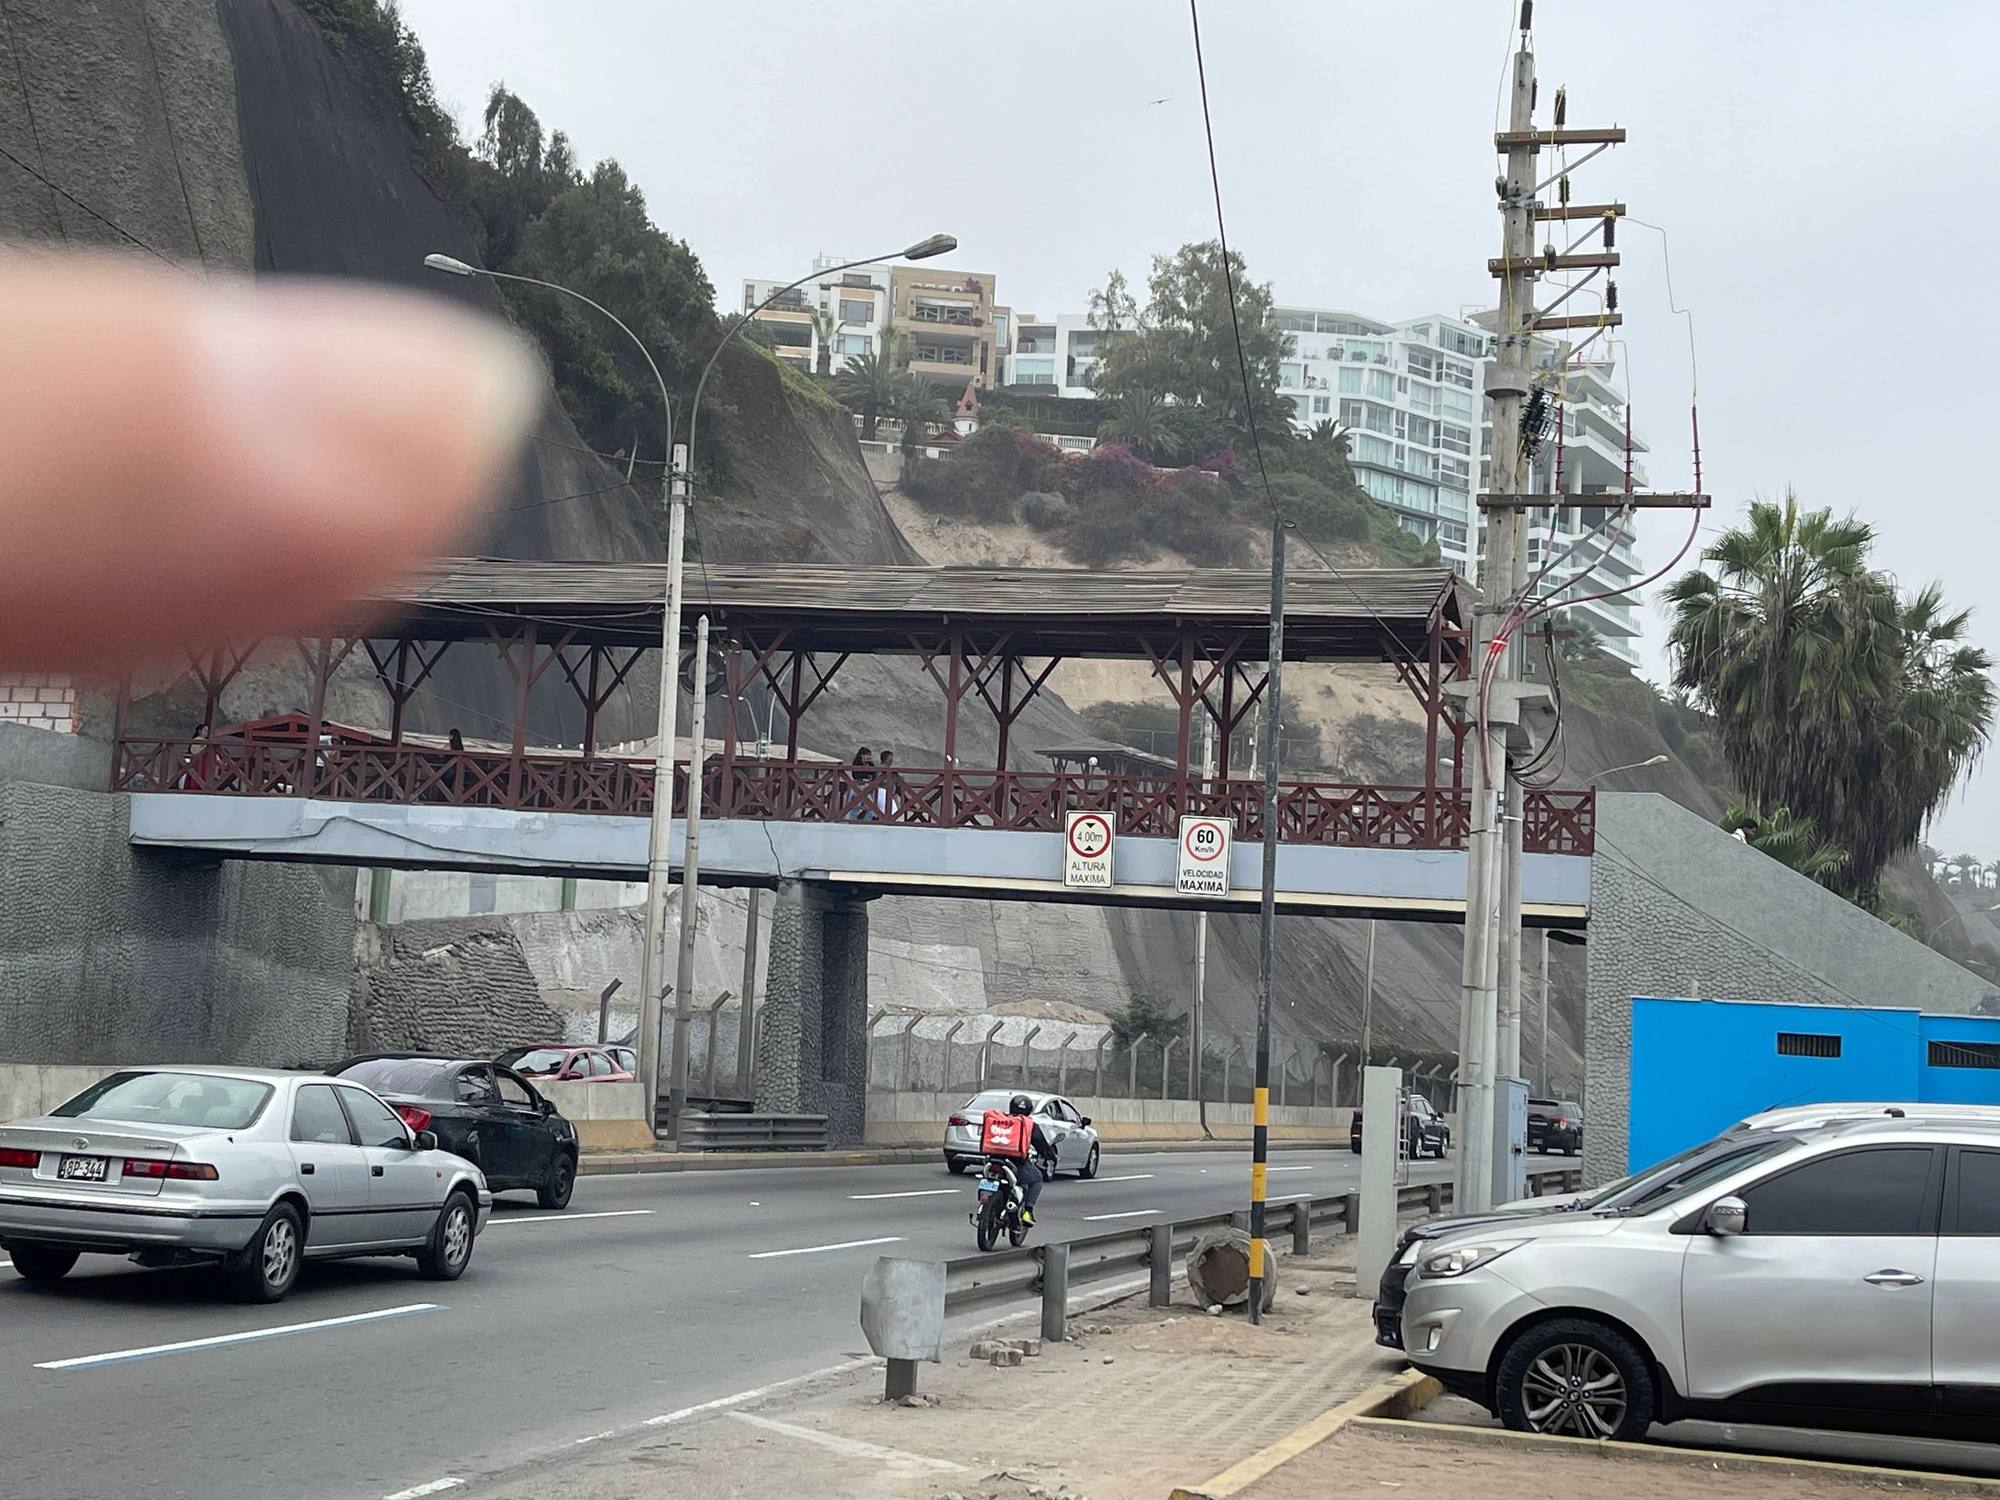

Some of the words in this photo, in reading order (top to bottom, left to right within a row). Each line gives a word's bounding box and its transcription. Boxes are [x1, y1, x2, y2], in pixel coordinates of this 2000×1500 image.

[1077, 831, 1103, 843] 4.00m
[1197, 829, 1214, 844] 60
[1071, 861, 1106, 872] ALTURA
[1070, 873, 1106, 884] MAXIMA
[1182, 869, 1224, 879] VELOCIDAD
[1179, 879, 1224, 892] MAXIMA
